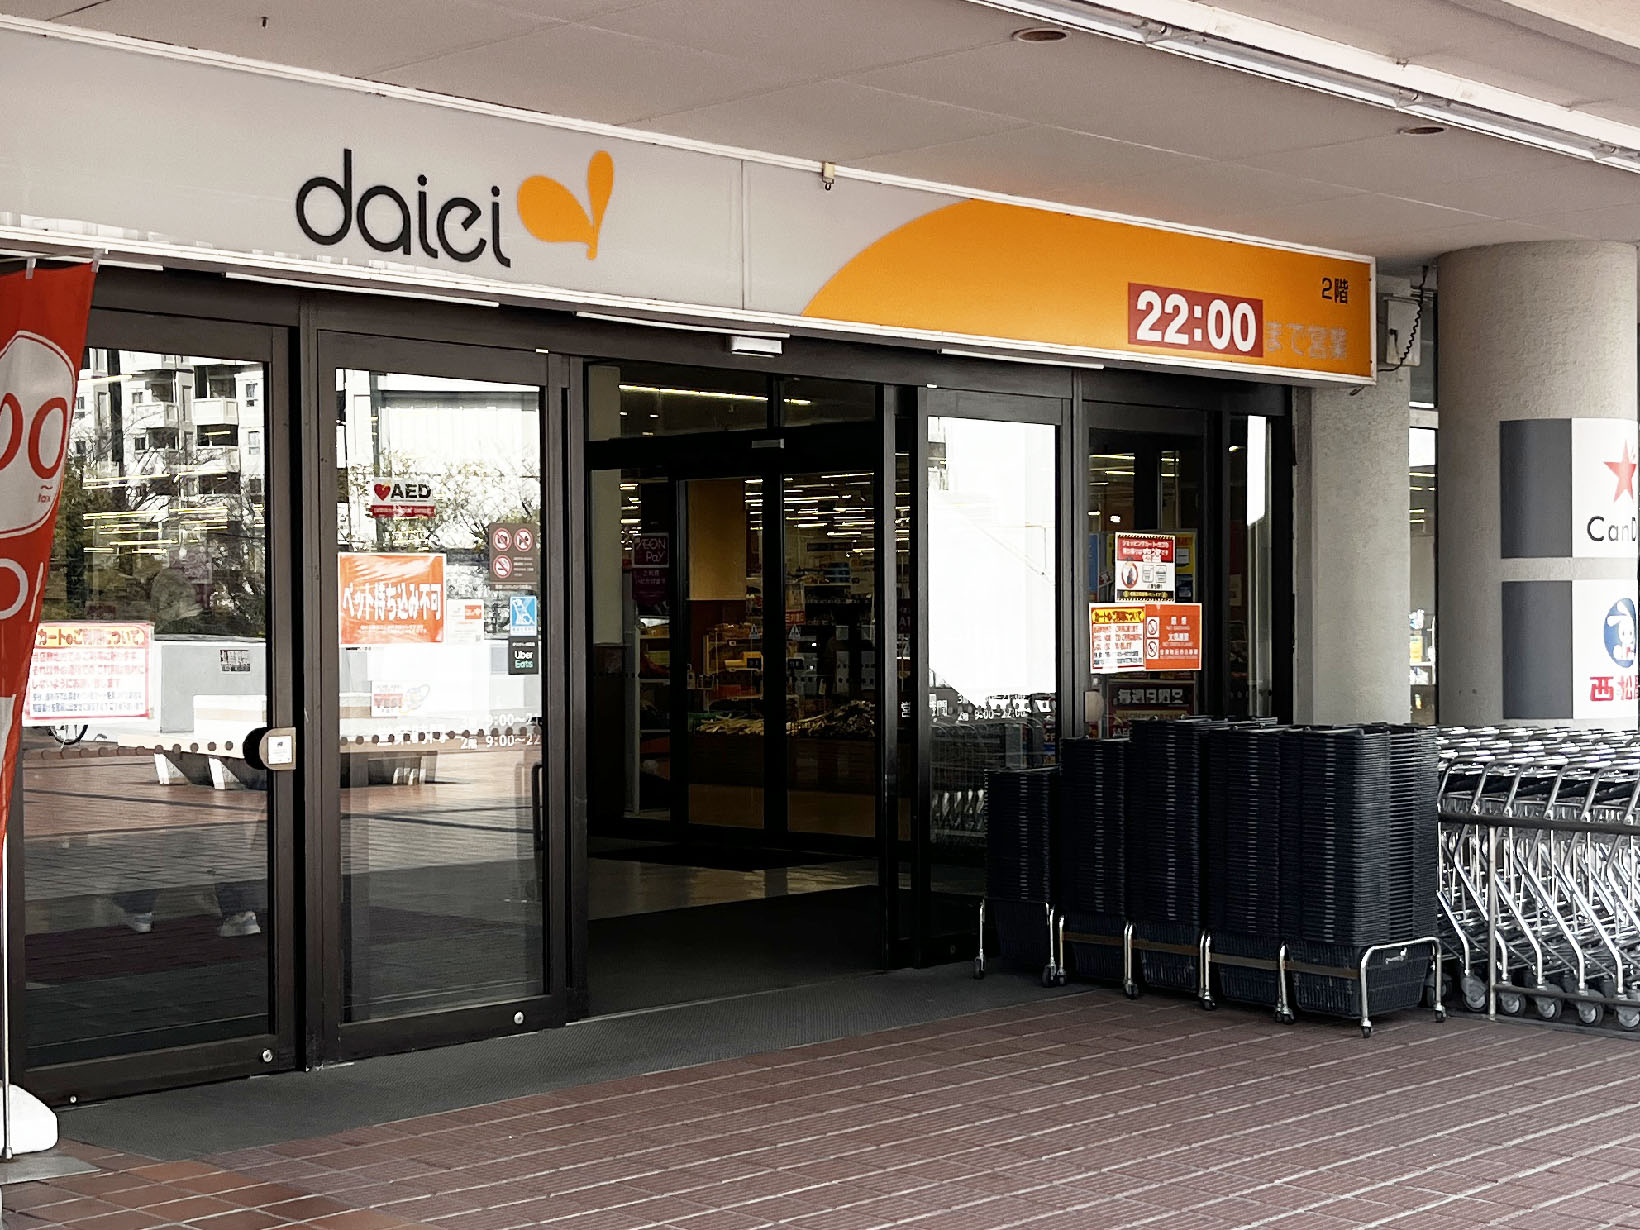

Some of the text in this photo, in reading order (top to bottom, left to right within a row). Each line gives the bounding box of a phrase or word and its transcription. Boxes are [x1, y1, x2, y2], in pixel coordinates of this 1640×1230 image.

[296, 148, 511, 268] daiei
[1321, 277, 1348, 304] 2階
[1136, 290, 1347, 360] 22:00 まで営業
[391, 484, 431, 498] AED
[343, 583, 441, 621] ペット持ち込み不可
[515, 651, 533, 659] Uber
[515, 660, 533, 668] Eats
